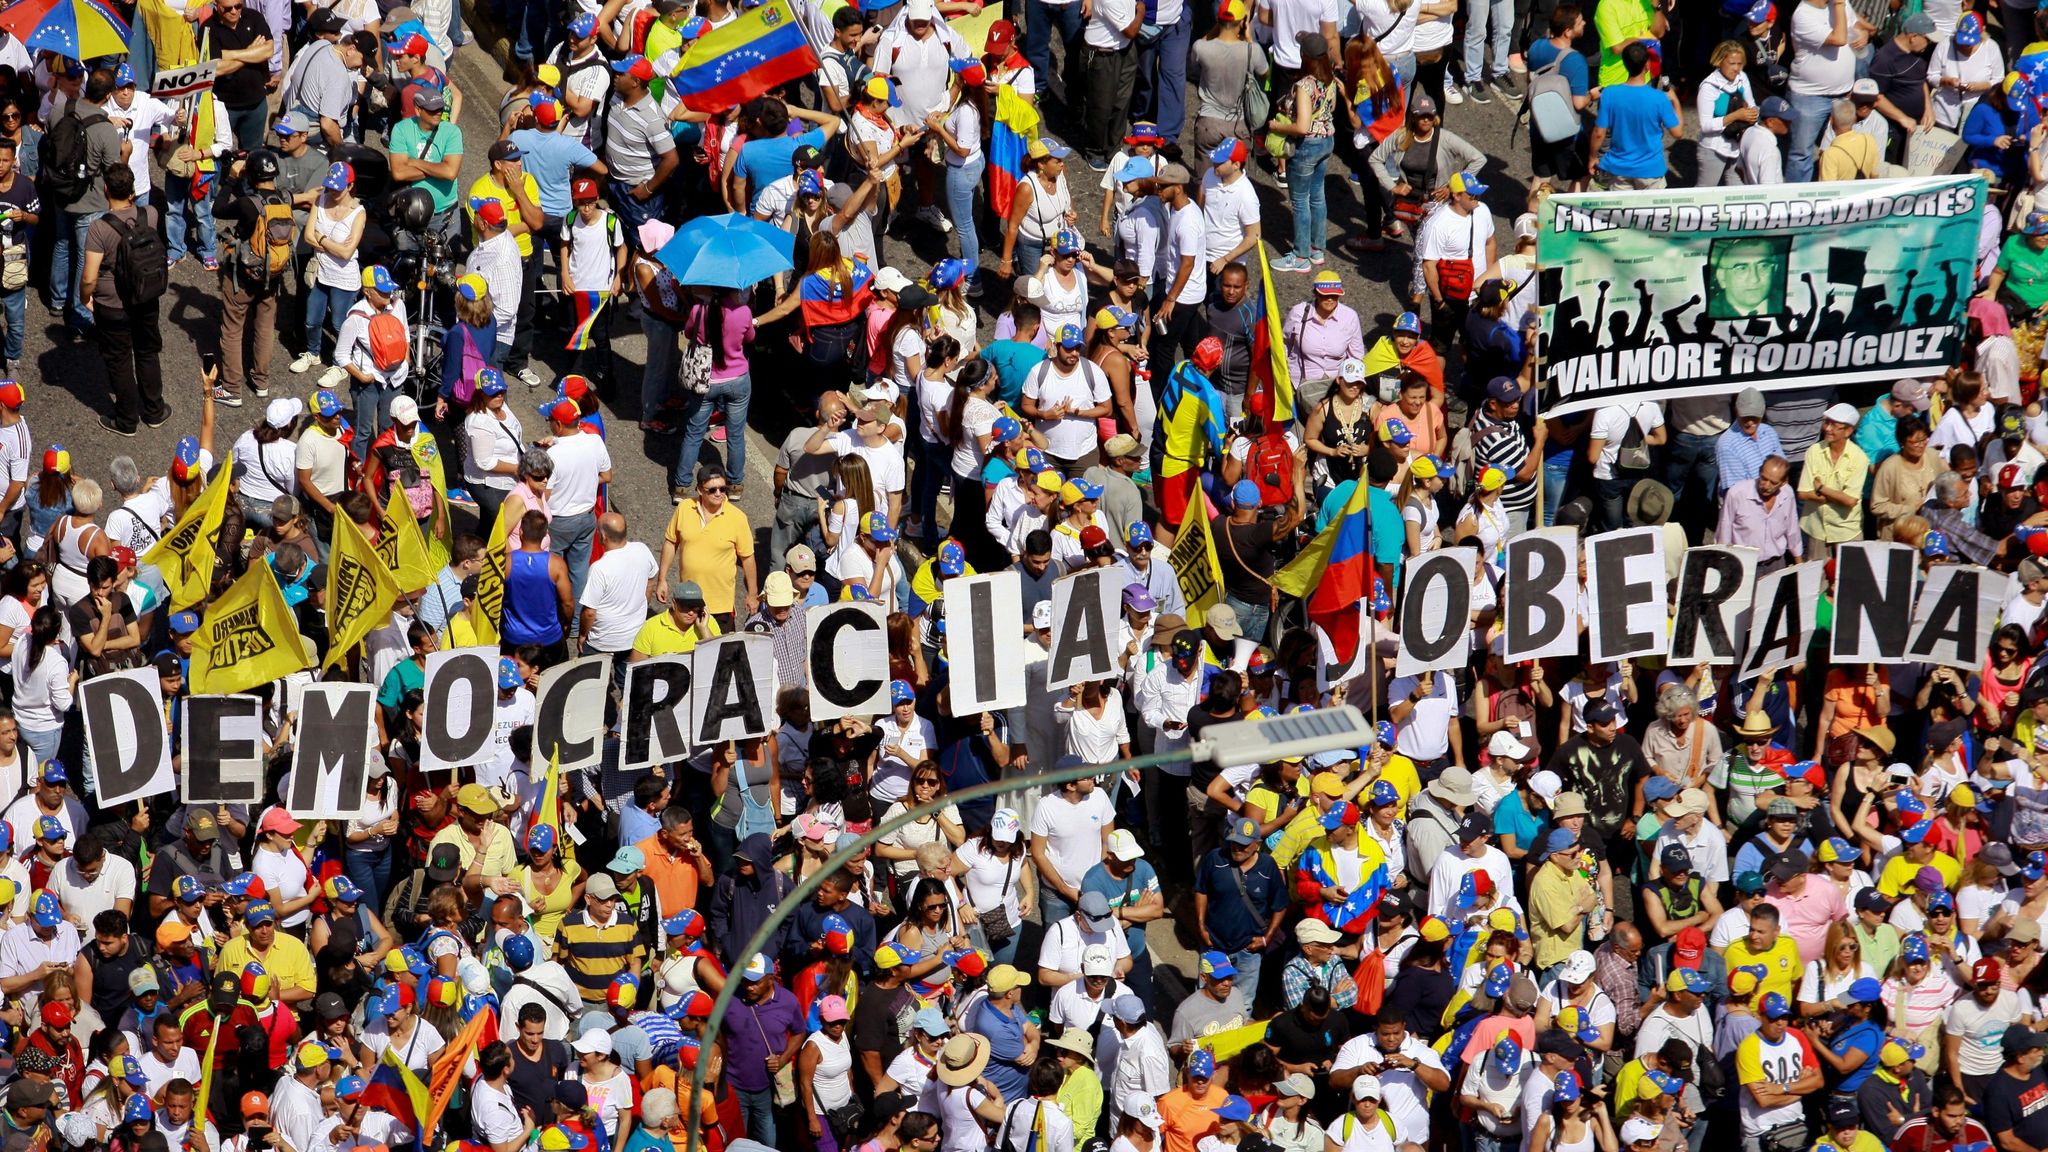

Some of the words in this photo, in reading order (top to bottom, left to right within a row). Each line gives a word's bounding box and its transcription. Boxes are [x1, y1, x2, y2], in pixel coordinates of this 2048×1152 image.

[158, 69, 212, 91] NO+
[1554, 203, 1671, 233] FRENTE
[1675, 205, 1720, 232] DE
[1723, 185, 1976, 231] TRABAJADORES
[1546, 342, 1724, 398] "VALMORE
[1326, 534, 1979, 679] OBERANA
